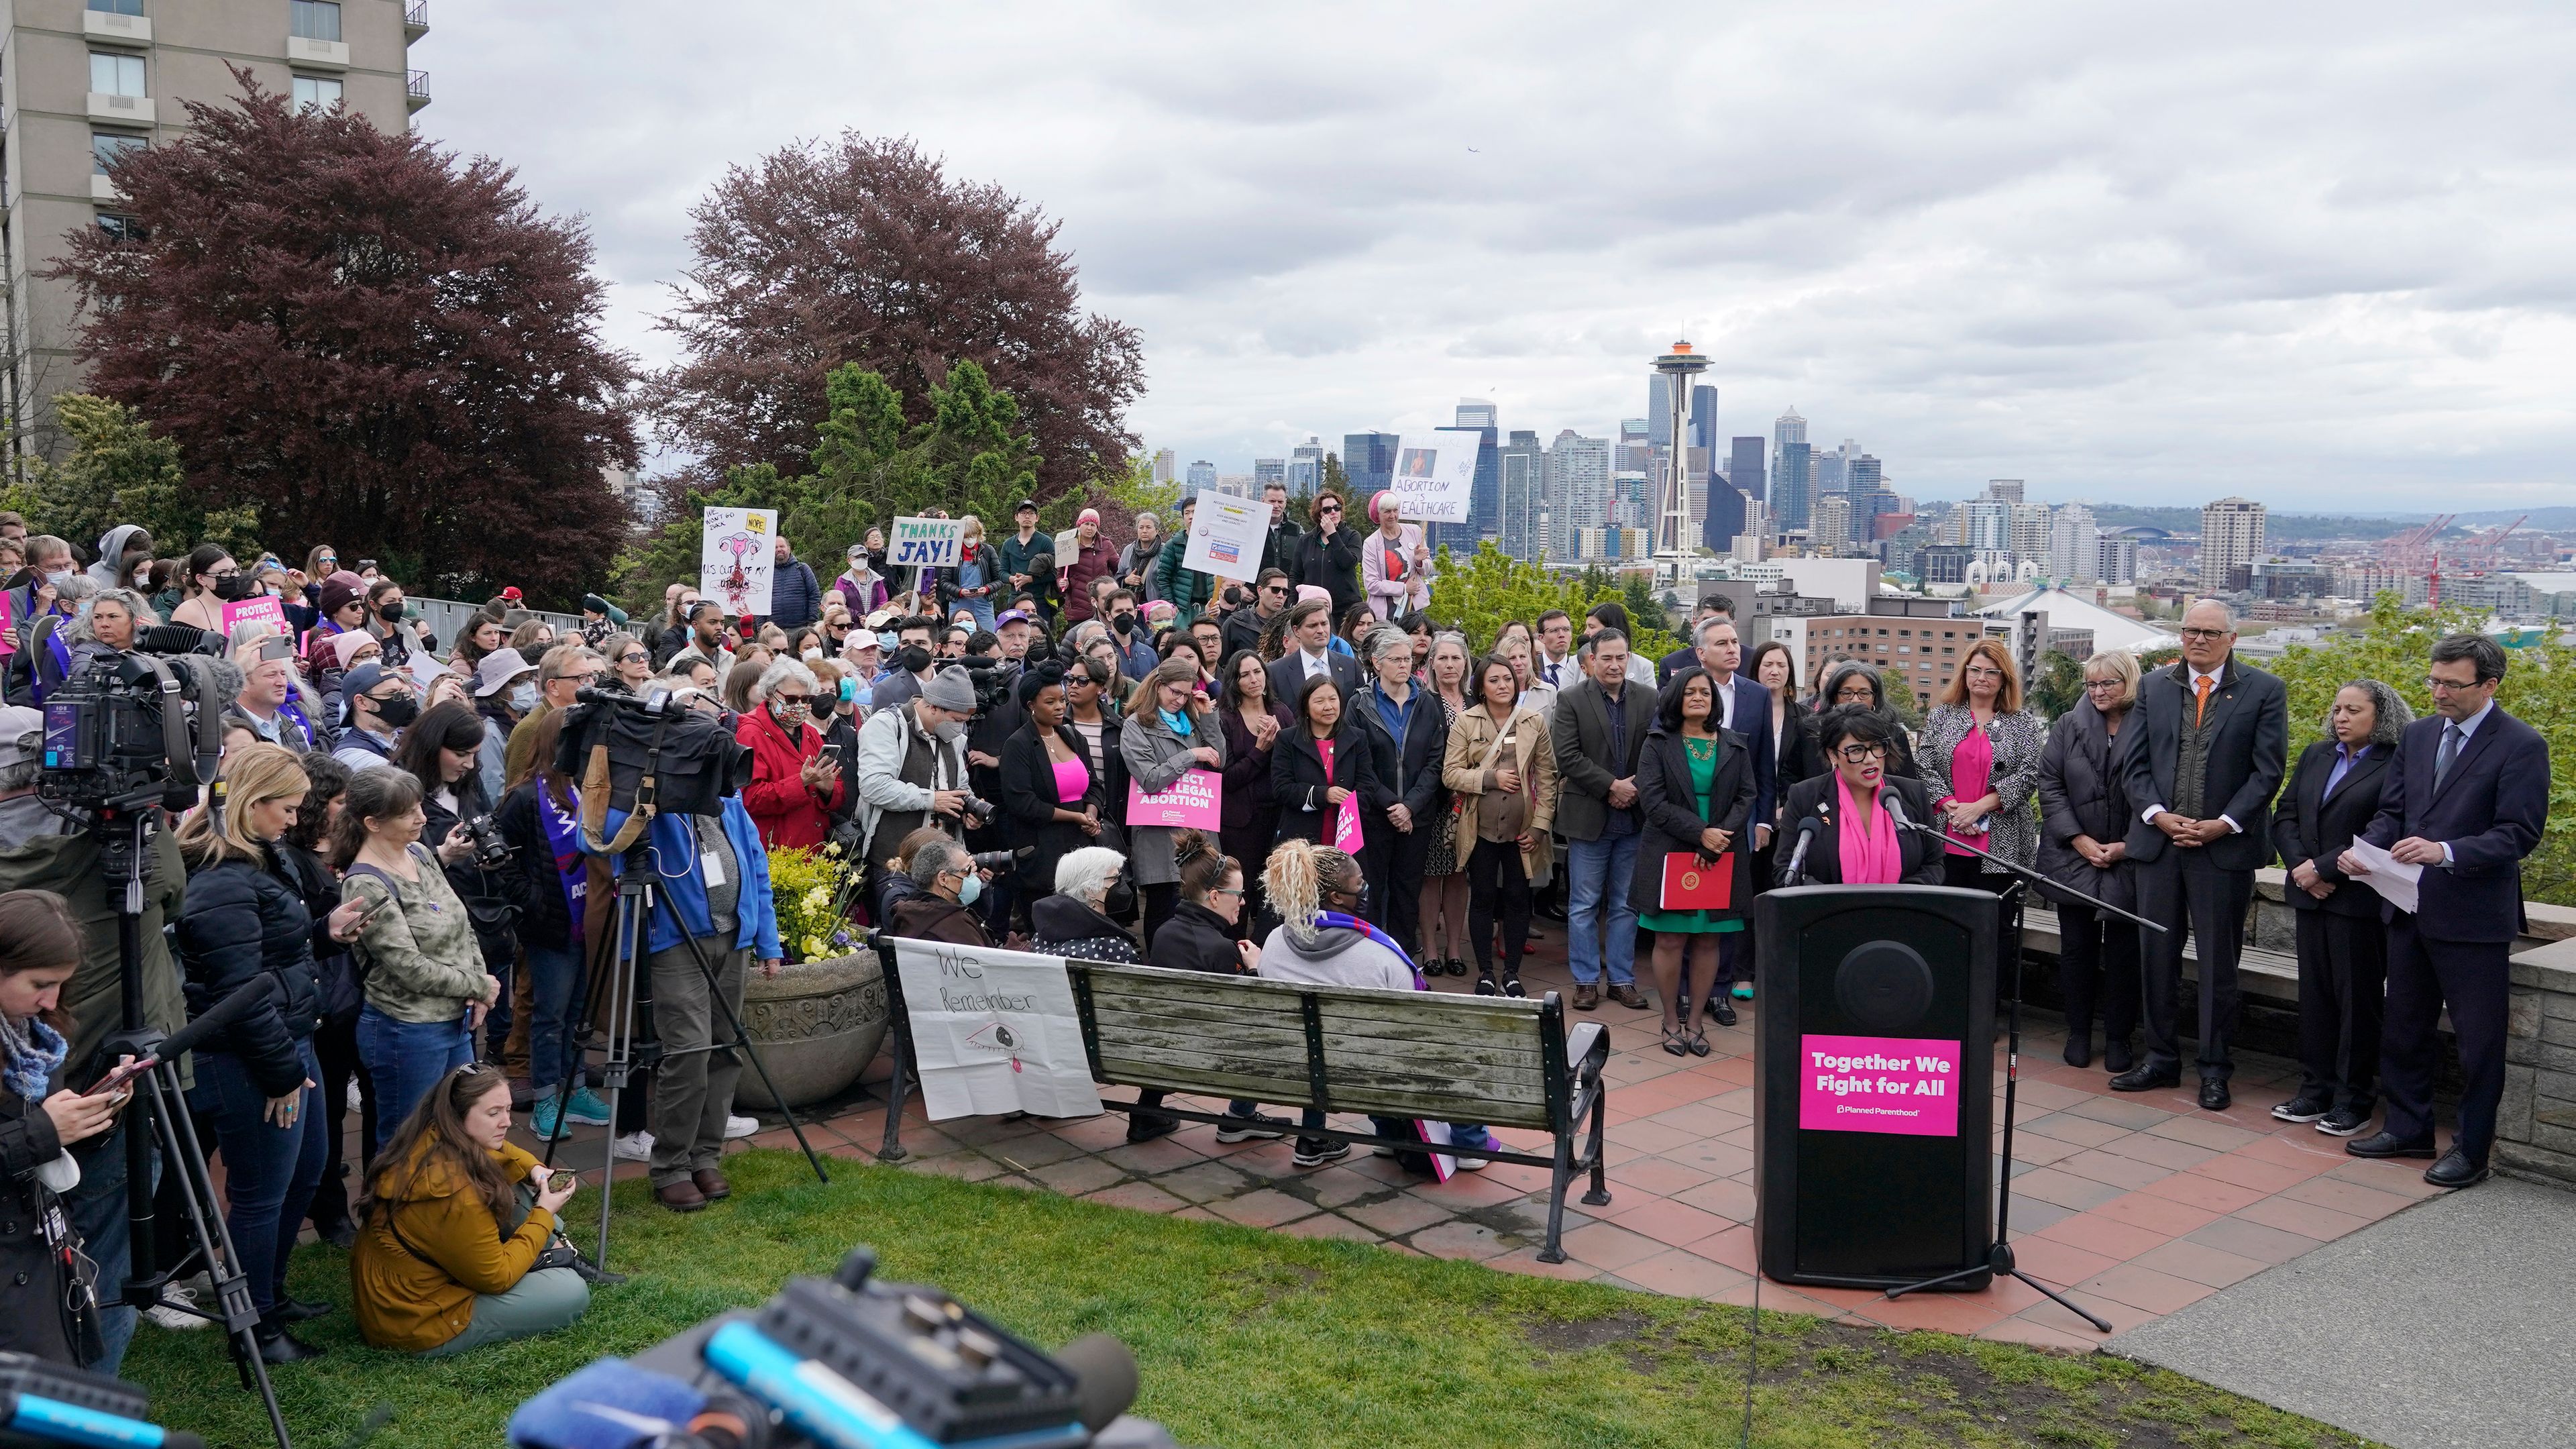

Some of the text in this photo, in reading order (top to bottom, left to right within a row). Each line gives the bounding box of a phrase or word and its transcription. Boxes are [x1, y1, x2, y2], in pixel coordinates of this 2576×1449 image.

[1395, 480, 1449, 492] ABORTION
[706, 508, 718, 517] WE
[710, 521, 726, 531] BACK
[748, 519, 765, 531] NOPE.
[900, 523, 957, 538] THANKS
[898, 539, 953, 563] JAY!
[720, 566, 734, 575] OUT
[744, 566, 752, 575] OF
[755, 566, 767, 577] MY
[720, 580, 749, 589] UTERUS
[235, 602, 273, 618] PROTECT
[1175, 784, 1214, 798] LEGAL
[1140, 794, 1209, 808] ABORTION
[936, 947, 982, 978] We
[940, 987, 1036, 1014] Remember
[1812, 1052, 1951, 1073] Together We
[1817, 1074, 1945, 1096] Fight for All
[1845, 1106, 1919, 1117] Planned Parenthood
